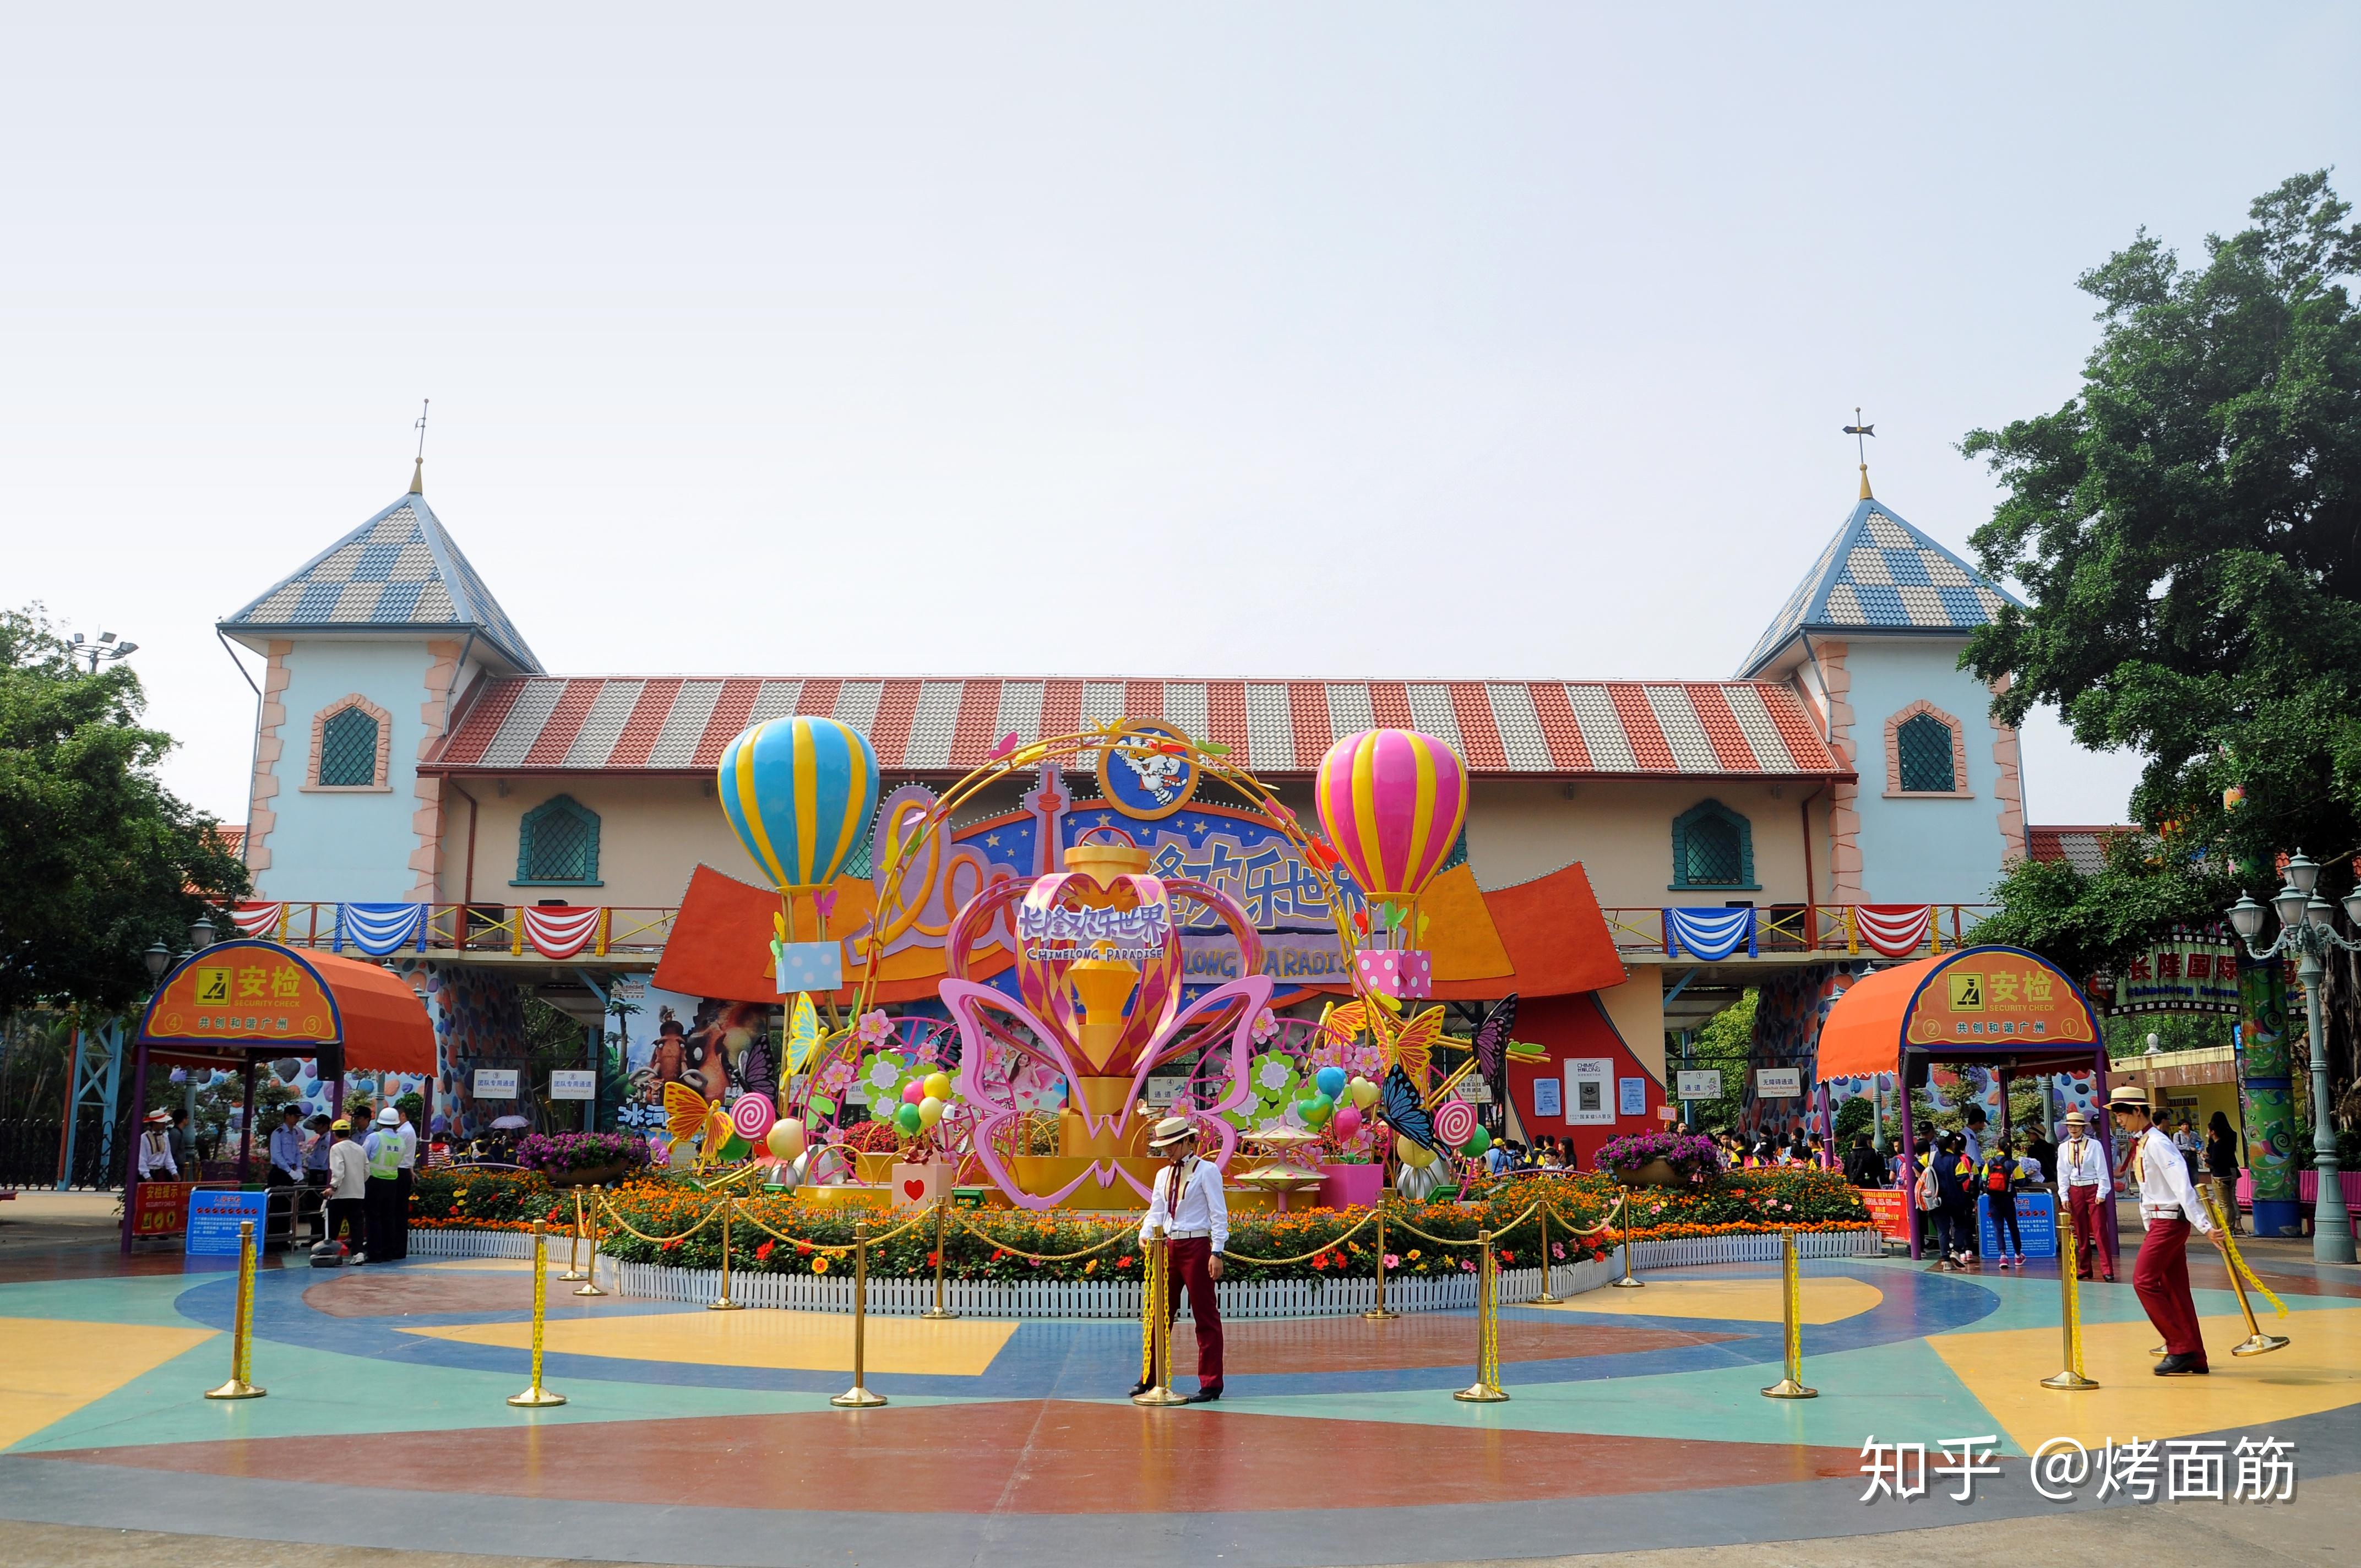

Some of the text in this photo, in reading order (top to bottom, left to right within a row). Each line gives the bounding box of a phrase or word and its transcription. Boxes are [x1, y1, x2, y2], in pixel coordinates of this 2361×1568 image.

[1018, 902, 1169, 946] 长隆欢乐世界
[1026, 947, 1163, 961] CHIMELONG PARADISE
[238, 966, 301, 998] 安检
[1990, 971, 2053, 1003] 安检
[198, 1016, 288, 1030] 共创和谐广州
[1956, 1021, 2045, 1033] 共创和谐广州
[146, 1185, 178, 1199] 安检提示
